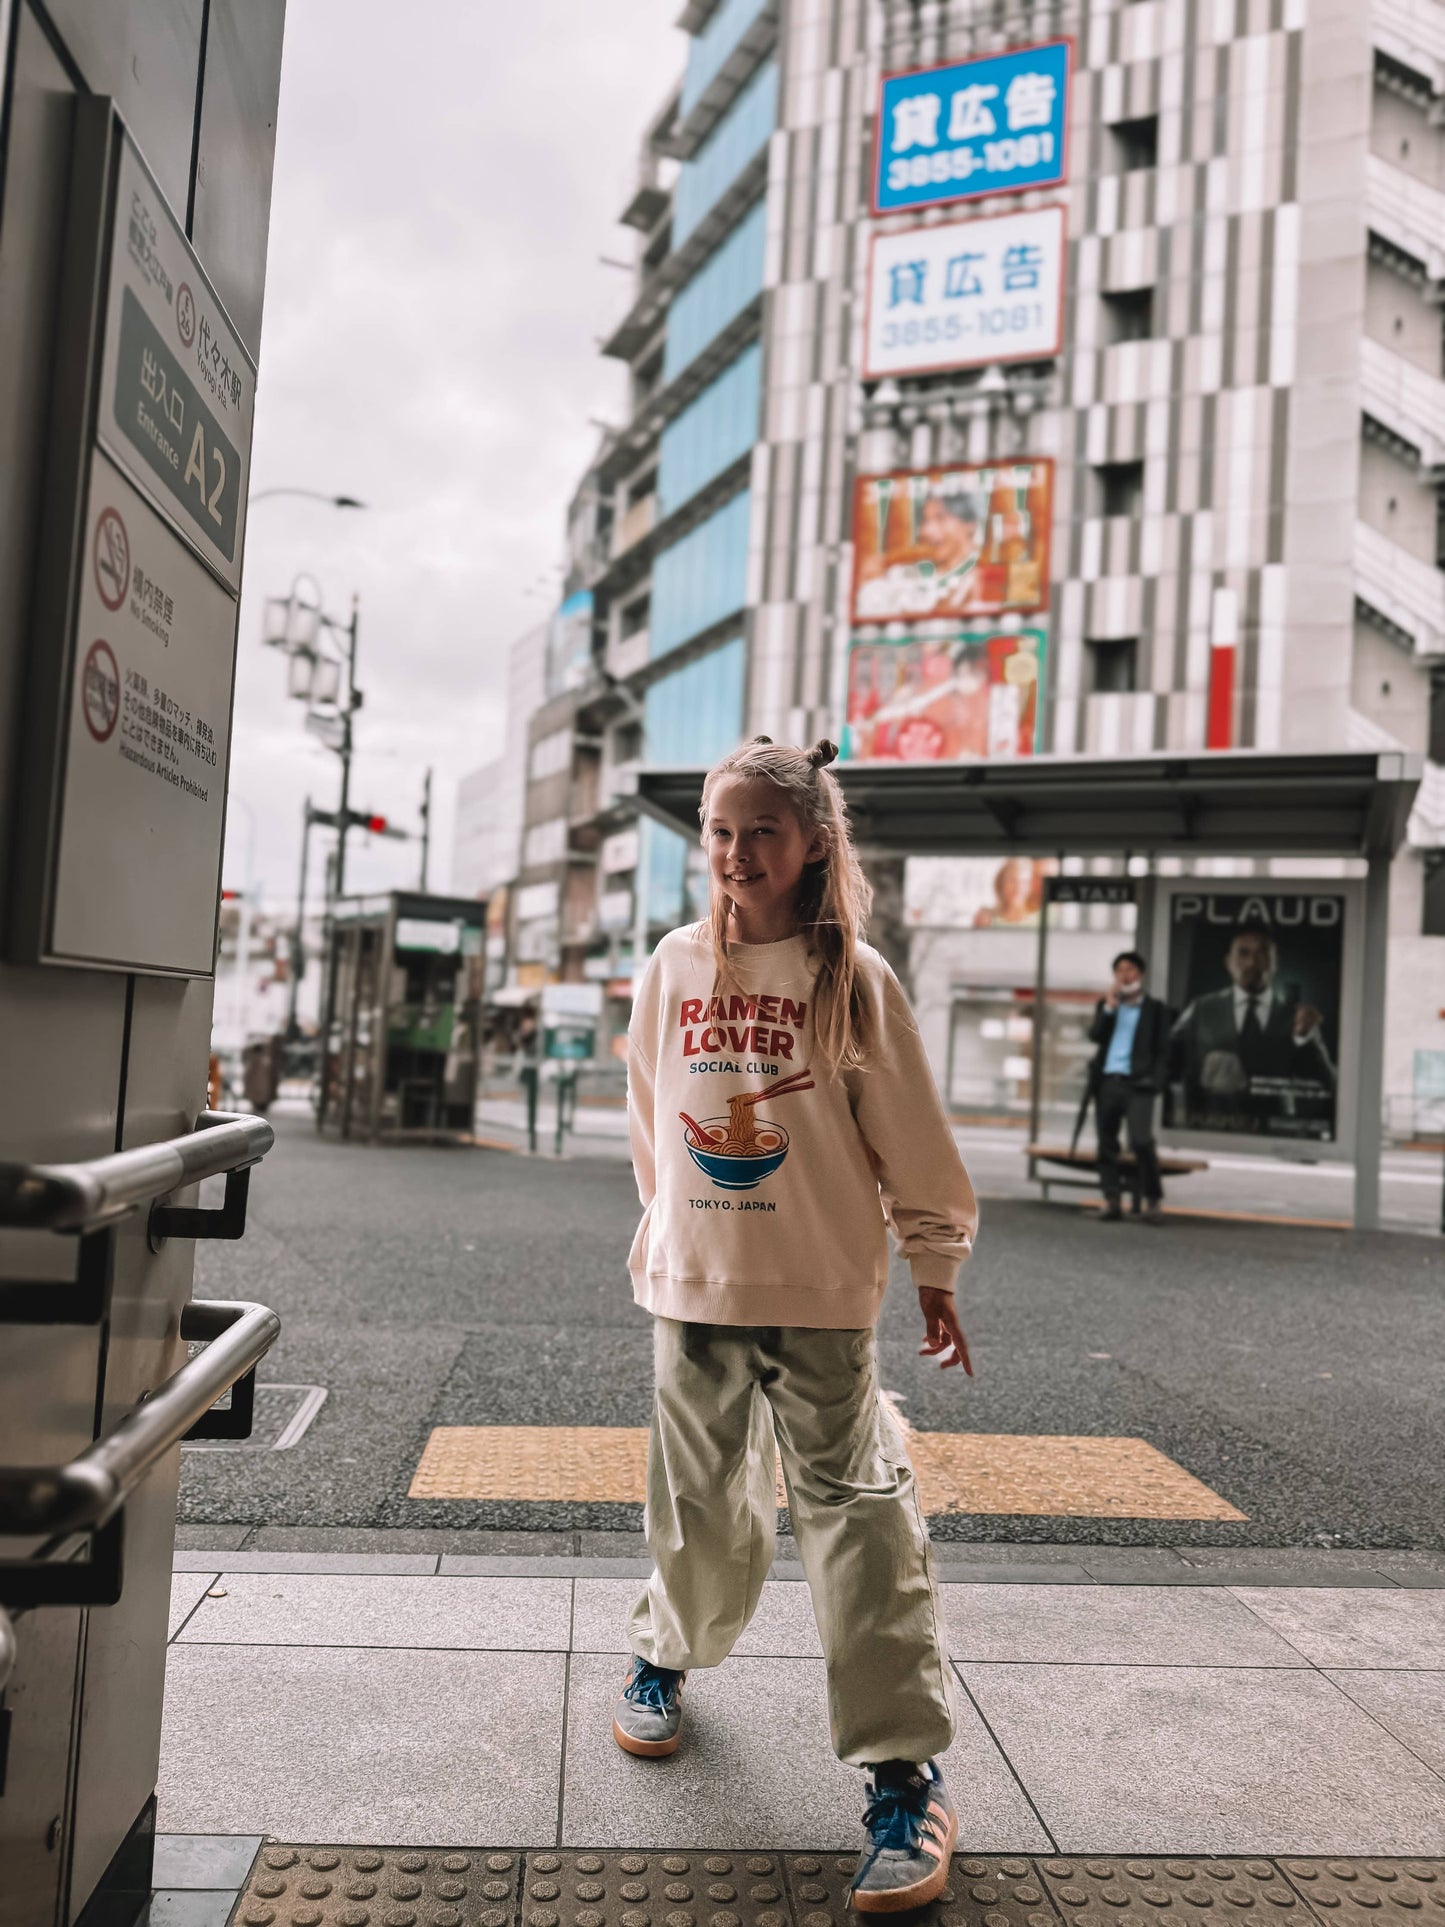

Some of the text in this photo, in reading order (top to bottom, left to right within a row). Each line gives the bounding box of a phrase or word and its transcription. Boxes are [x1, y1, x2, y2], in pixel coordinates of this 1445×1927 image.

[890, 73, 1057, 153] 貸広告
[886, 242, 1044, 310] 貸広告
[197, 347, 228, 411] Yoyogi Sta.
[199, 314, 241, 411] 代々木駅
[141, 347, 184, 435] 出入口
[137, 401, 179, 470] Entrance
[184, 419, 226, 527] A2
[130, 598, 169, 648] No Smoking
[121, 714, 179, 765] ことはできません。
[156, 762, 180, 787] Articles
[180, 774, 209, 802] Prohibited
[1175, 895, 1340, 926] PLAUD
[679, 994, 808, 1030] RAMEN
[683, 1026, 794, 1061] LOVER
[689, 1061, 779, 1076] SOCIAL CLUB
[737, 1201, 776, 1212] JAPAN
